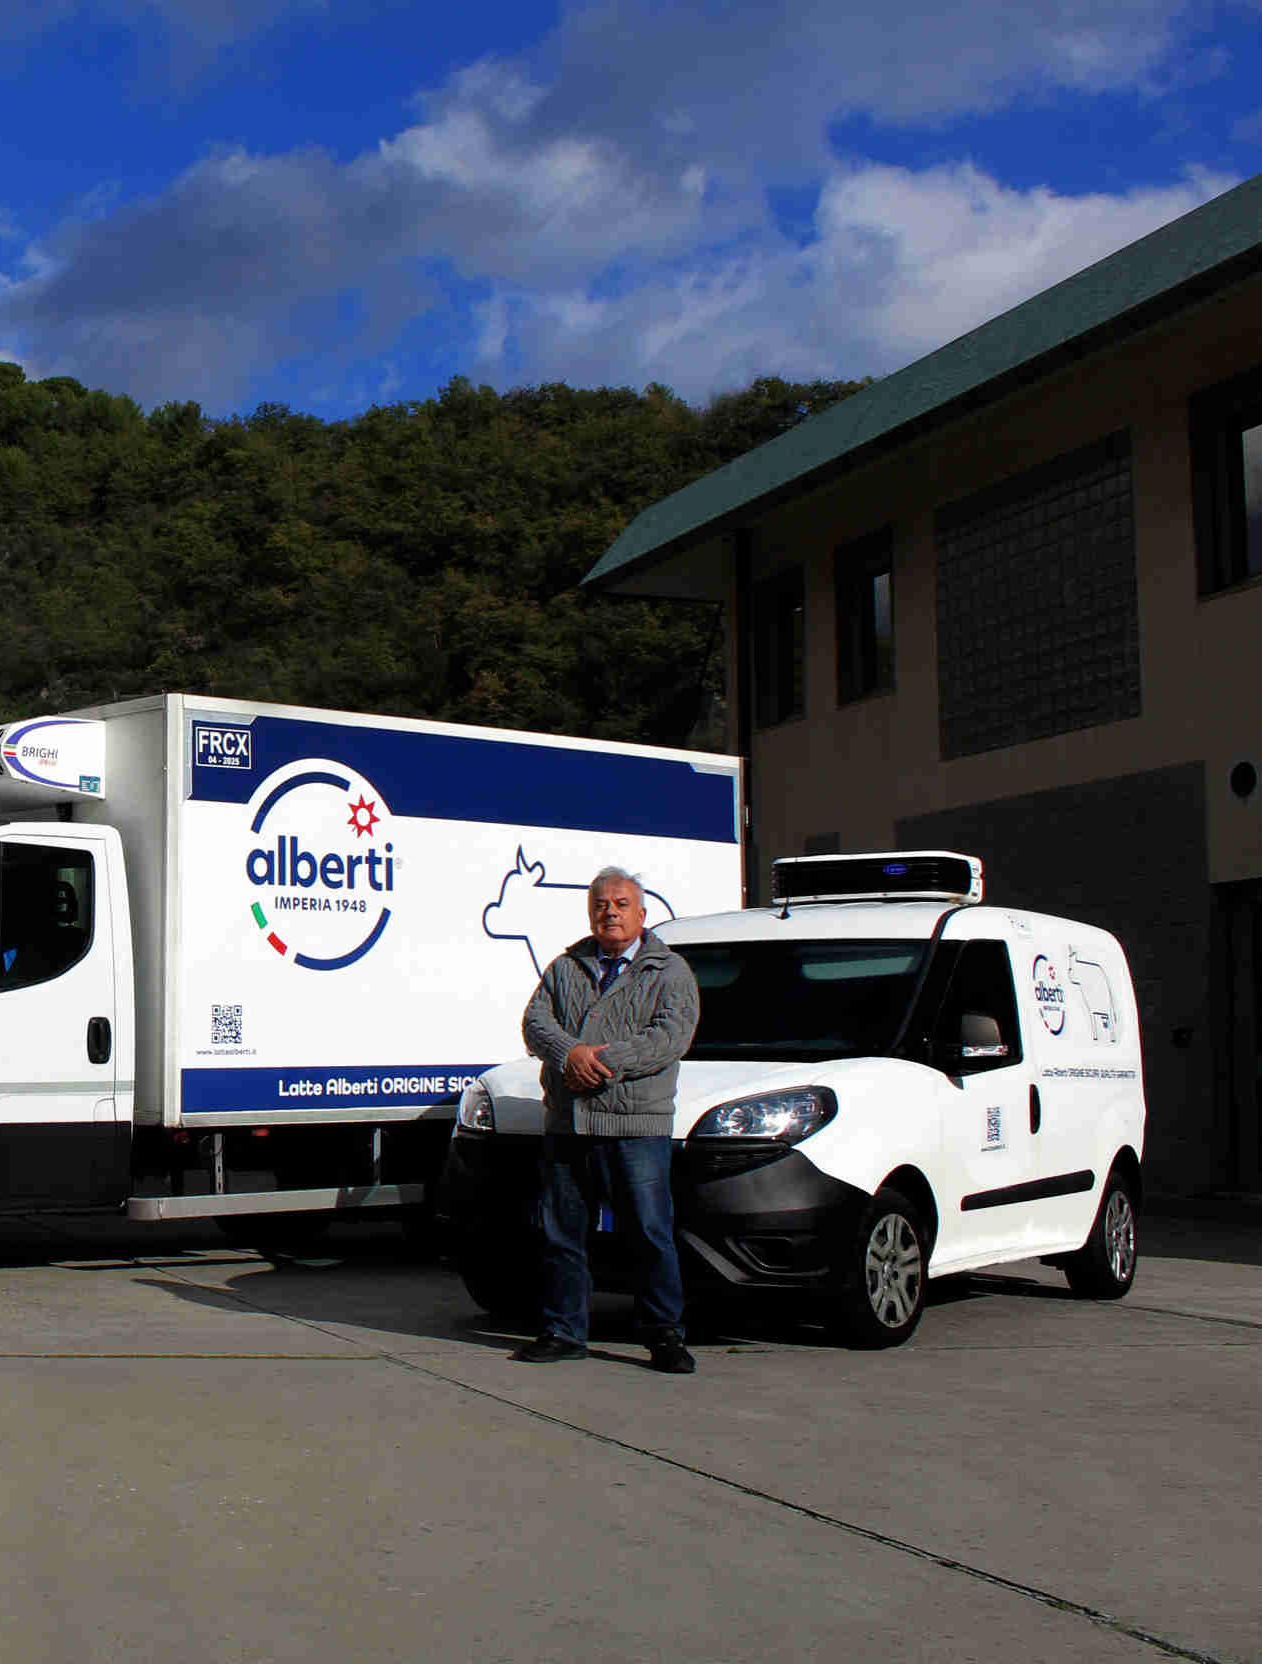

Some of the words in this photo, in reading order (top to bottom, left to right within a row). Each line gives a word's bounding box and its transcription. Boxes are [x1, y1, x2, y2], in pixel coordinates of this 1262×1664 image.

[21, 746, 59, 760] BRIGHI
[198, 730, 249, 756] FRCX
[208, 755, 217, 764] 04
[222, 756, 240, 765] 2025
[246, 835, 394, 891] alberti
[274, 896, 332, 911] IMPERIA
[335, 899, 367, 913] 1948
[1034, 981, 1064, 1003] alberti
[279, 1079, 323, 1097] Latte
[326, 1078, 378, 1096] Alberti
[381, 1077, 445, 1094] ORIGINE
